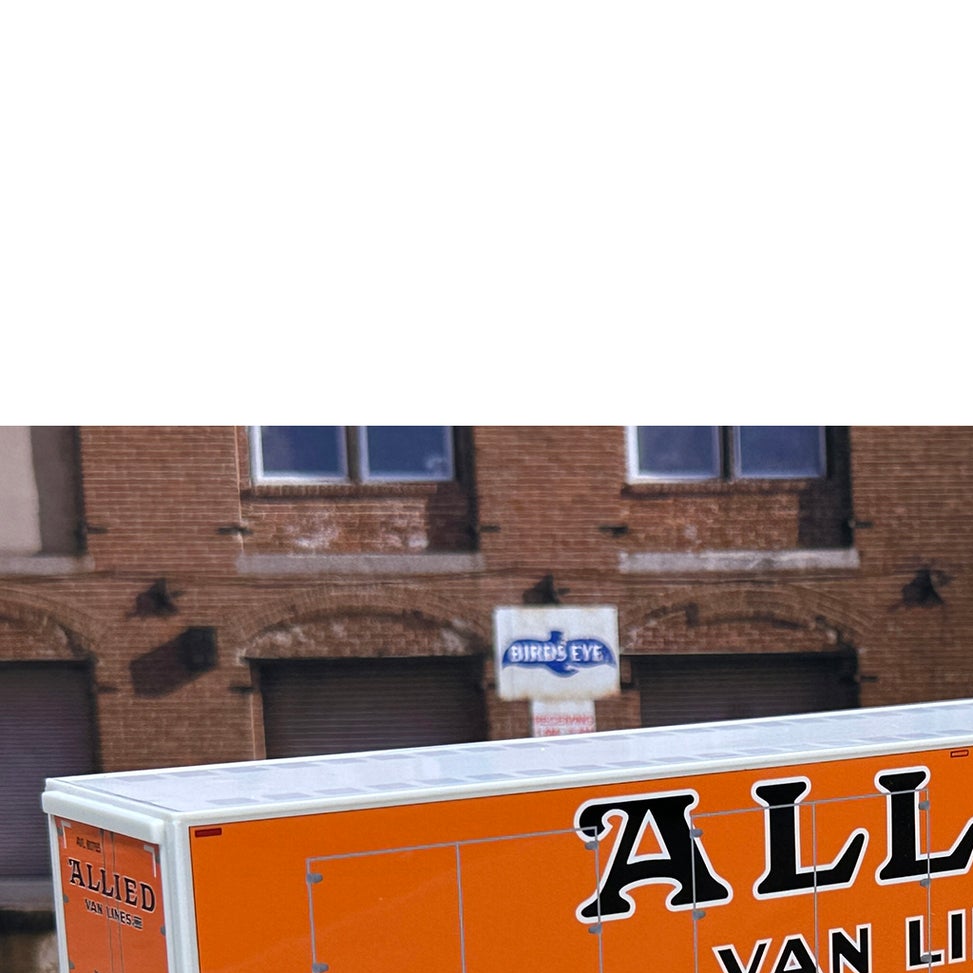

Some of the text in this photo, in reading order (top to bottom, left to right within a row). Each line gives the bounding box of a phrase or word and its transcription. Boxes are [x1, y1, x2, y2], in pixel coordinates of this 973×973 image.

[571, 645, 604, 662] EYE
[67, 855, 157, 915] ALLIED
[85, 898, 104, 917] VAN
